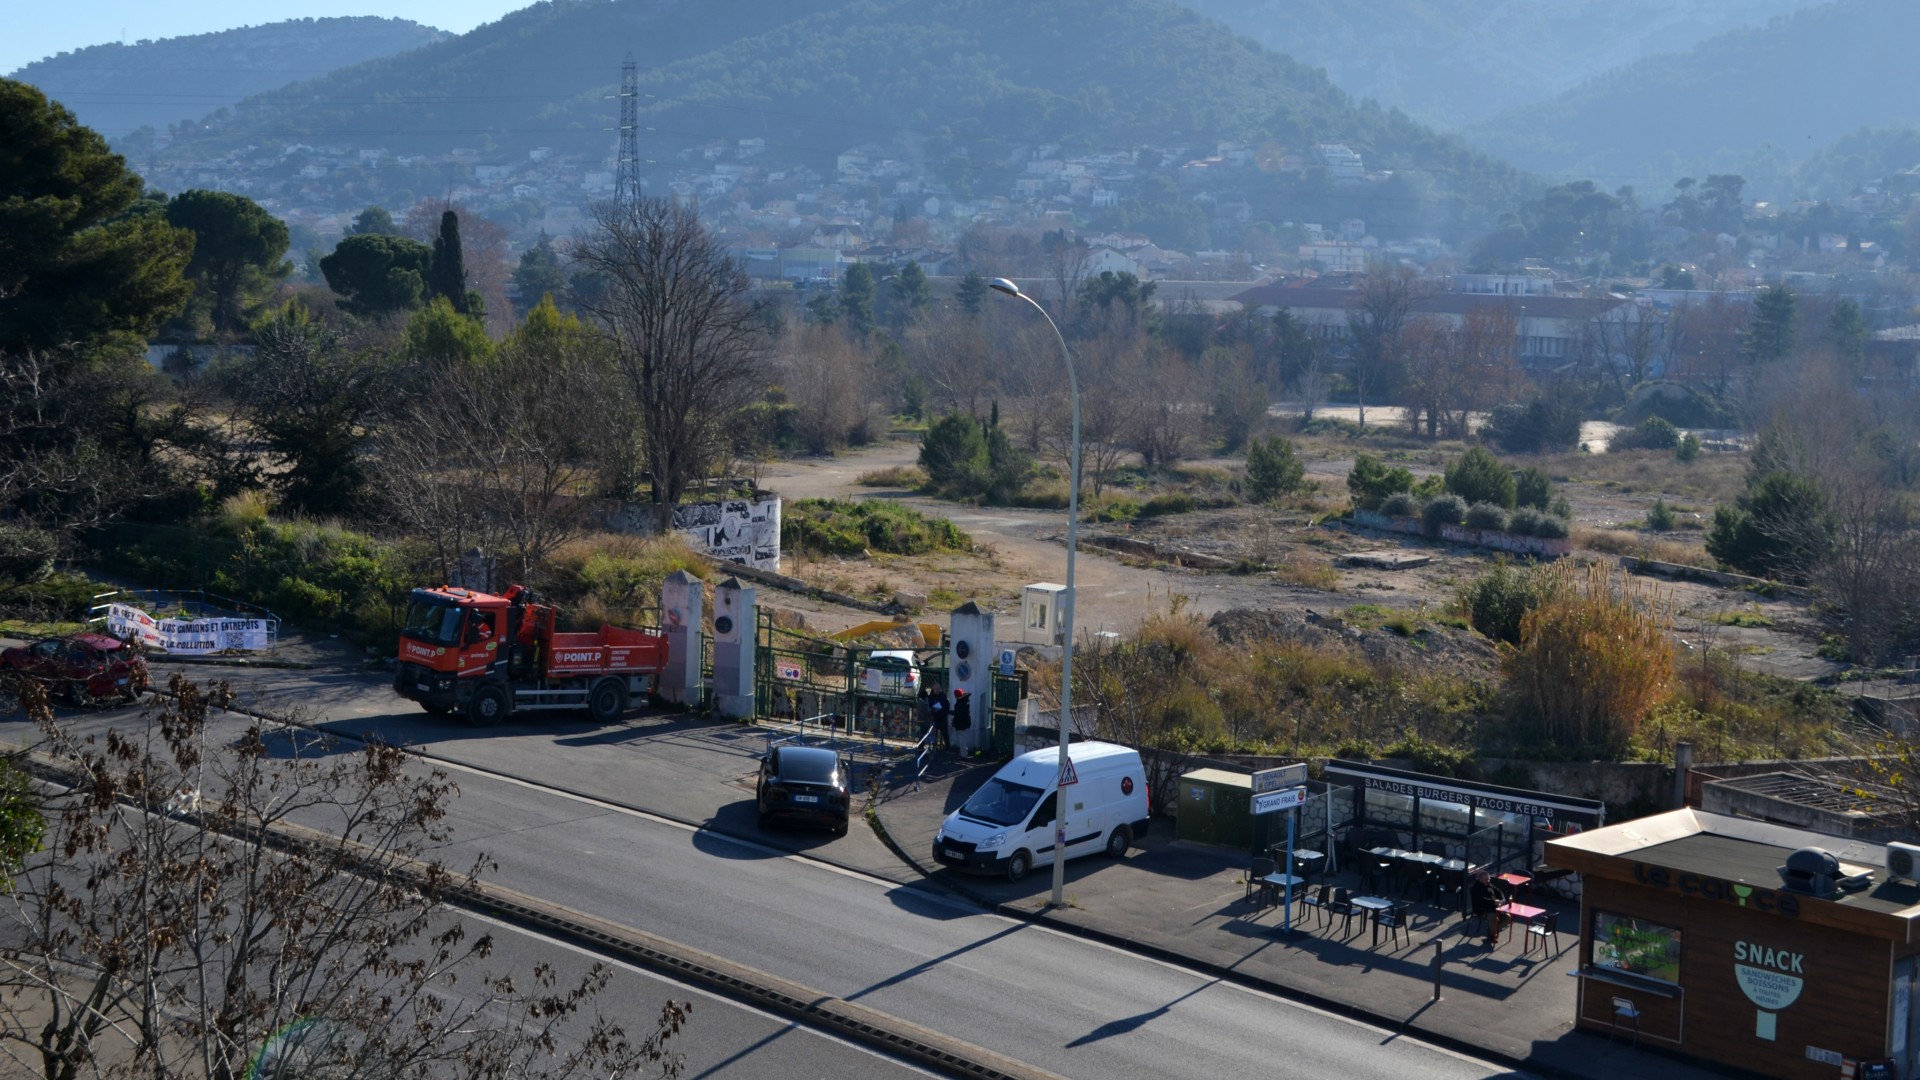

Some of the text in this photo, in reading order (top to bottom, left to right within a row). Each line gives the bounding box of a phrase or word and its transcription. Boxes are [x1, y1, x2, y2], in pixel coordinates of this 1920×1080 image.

[162, 622, 176, 633] VOS
[177, 622, 209, 634] CAMIONS
[211, 622, 219, 632] ET
[411, 645, 436, 658] POINT.P
[563, 652, 602, 662] POINT.P
[1263, 770, 1286, 780] RENAULT
[1265, 780, 1277, 789] OPEL
[1262, 795, 1296, 809] GRAND FRAIS
[1364, 778, 1554, 818] SALADES BURGERS TACOS KEBAB
[1734, 940, 1804, 974] SNACK
[1741, 967, 1797, 987] SANDWICHES
[1747, 977, 1790, 993] BOISSONS
[1759, 988, 1781, 999] TOUTES
